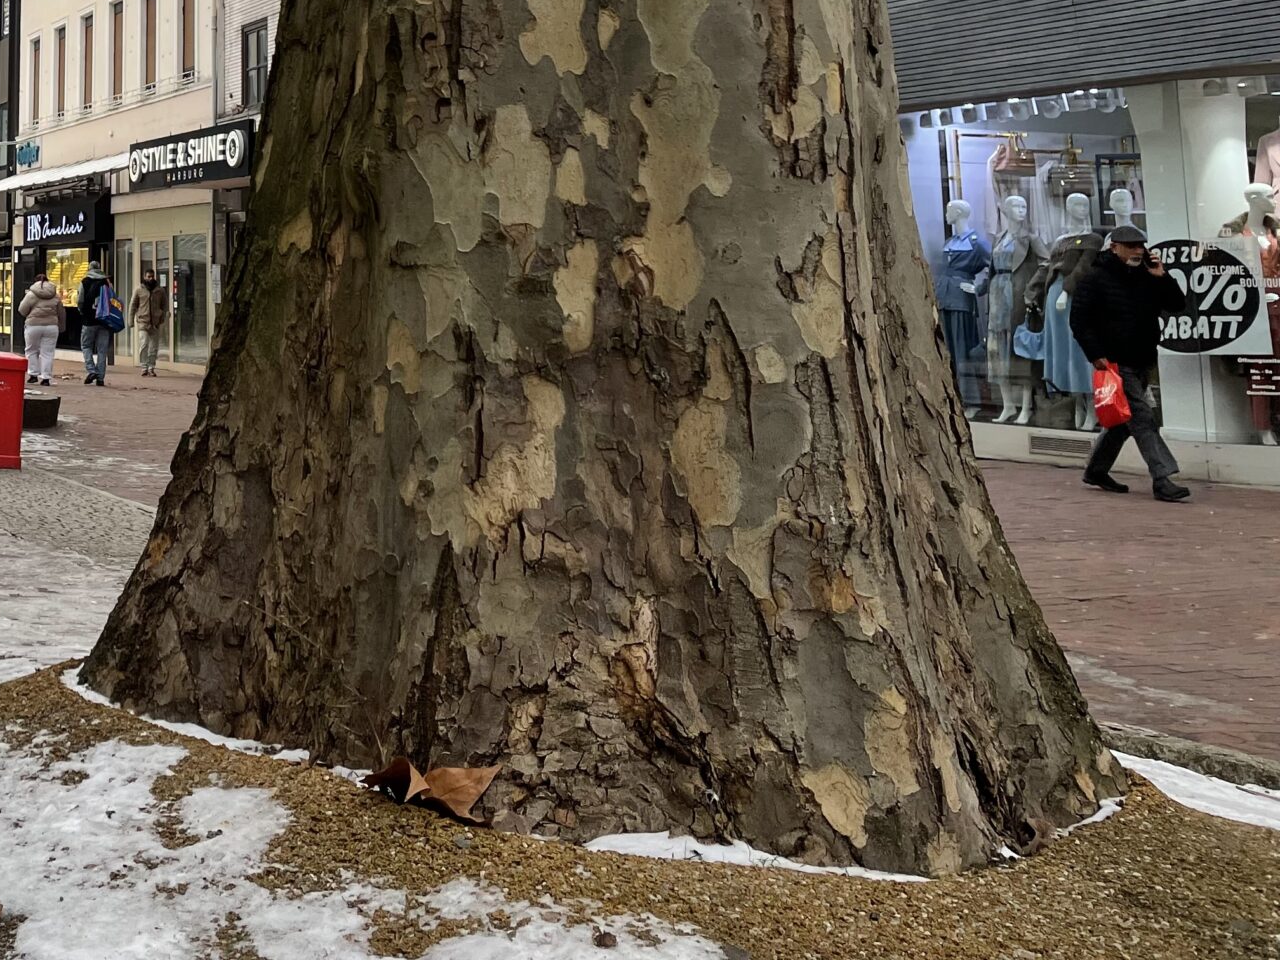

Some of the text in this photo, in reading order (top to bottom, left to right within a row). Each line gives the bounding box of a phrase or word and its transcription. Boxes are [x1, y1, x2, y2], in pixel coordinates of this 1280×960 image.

[141, 143, 177, 174] STYLE
[177, 142, 187, 168] &
[187, 133, 227, 166] SHINE
[166, 167, 204, 182] HARBURG
[1181, 246, 1204, 262] ZU
[1201, 265, 1245, 275] WELCOME
